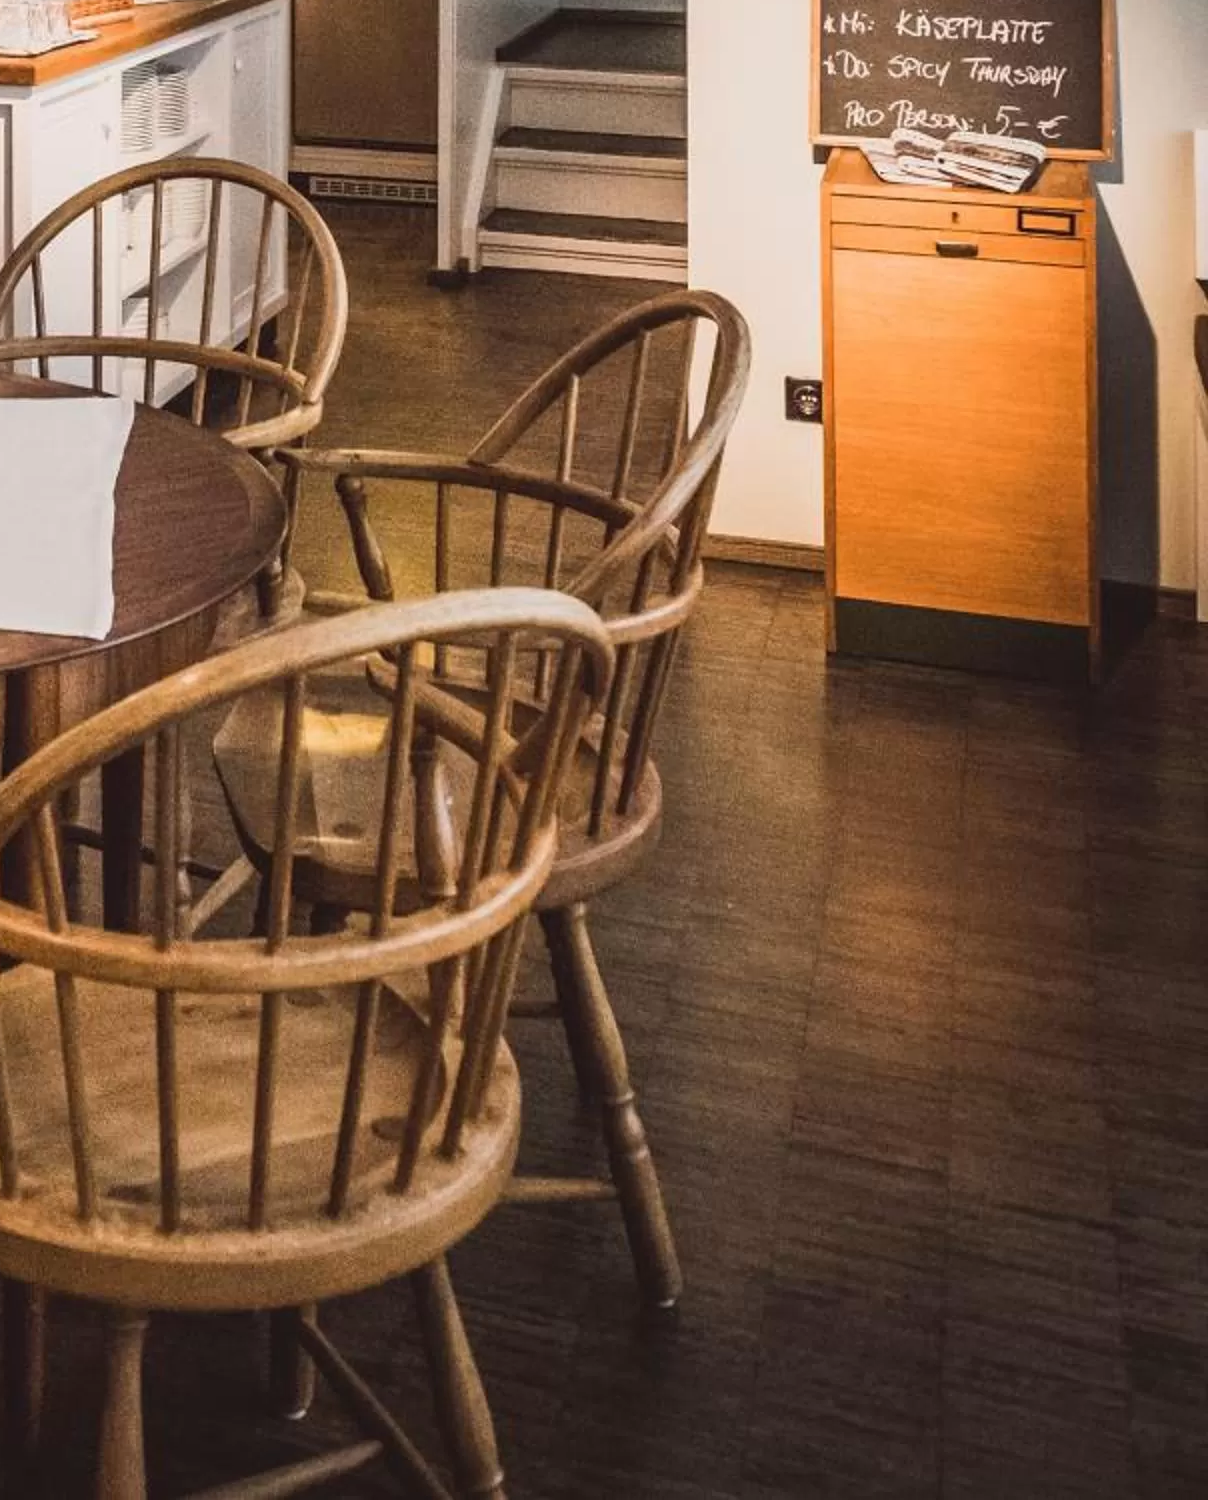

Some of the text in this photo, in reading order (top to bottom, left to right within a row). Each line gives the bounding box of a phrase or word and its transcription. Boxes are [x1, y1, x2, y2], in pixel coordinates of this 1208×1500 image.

[895, 8, 1053, 45] KÄSEPLATTE
[887, 55, 951, 87] SPICY
[961, 57, 1067, 98] THURSDAY
[843, 100, 884, 129] PRO
